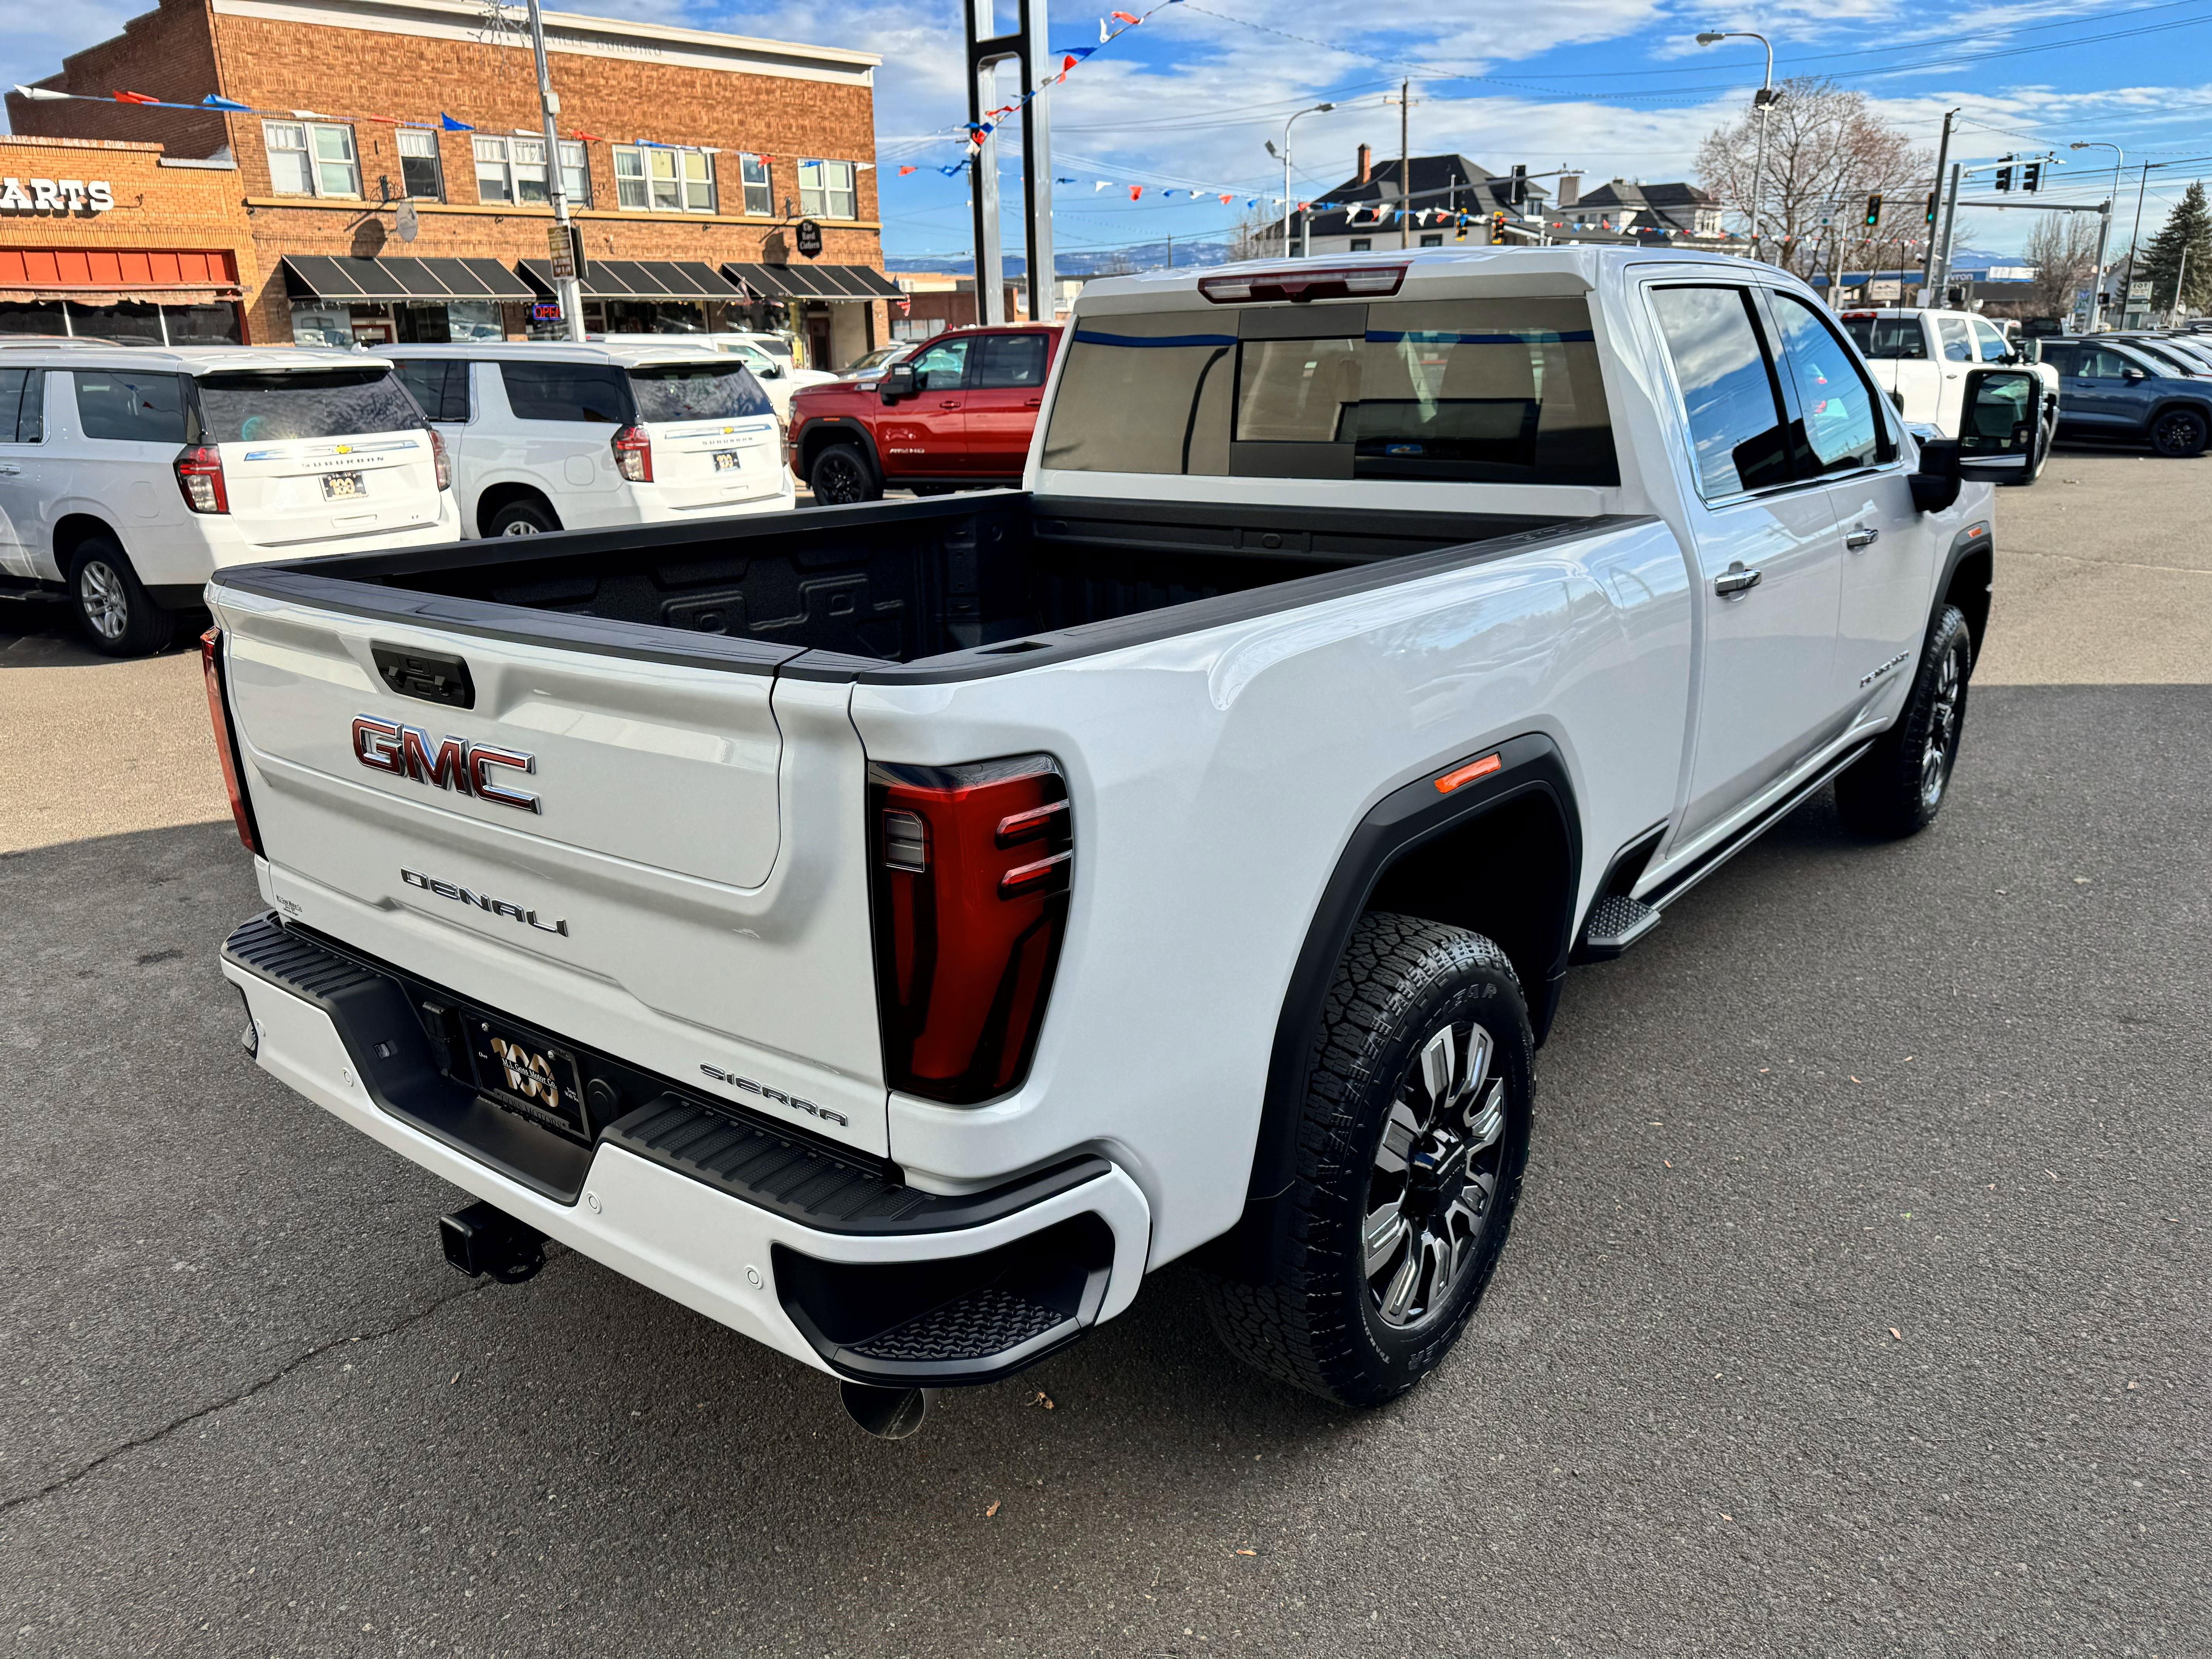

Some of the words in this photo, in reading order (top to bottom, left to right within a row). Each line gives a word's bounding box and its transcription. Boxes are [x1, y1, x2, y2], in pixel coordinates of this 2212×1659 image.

[0, 177, 114, 211] ARTS
[302, 456, 384, 467] SUBURBAN
[352, 713, 541, 815] GMC
[400, 866, 568, 937] DENALI
[491, 1037, 558, 1107] 100
[502, 1058, 514, 1069] M.J.
[515, 1064, 528, 1075] Goss
[529, 1070, 546, 1084] Motor
[547, 1078, 557, 1088] Co.
[700, 1062, 848, 1127] SIERRA
[501, 1095, 523, 1111] GOSS
[525, 1104, 562, 1128] MOTORS
